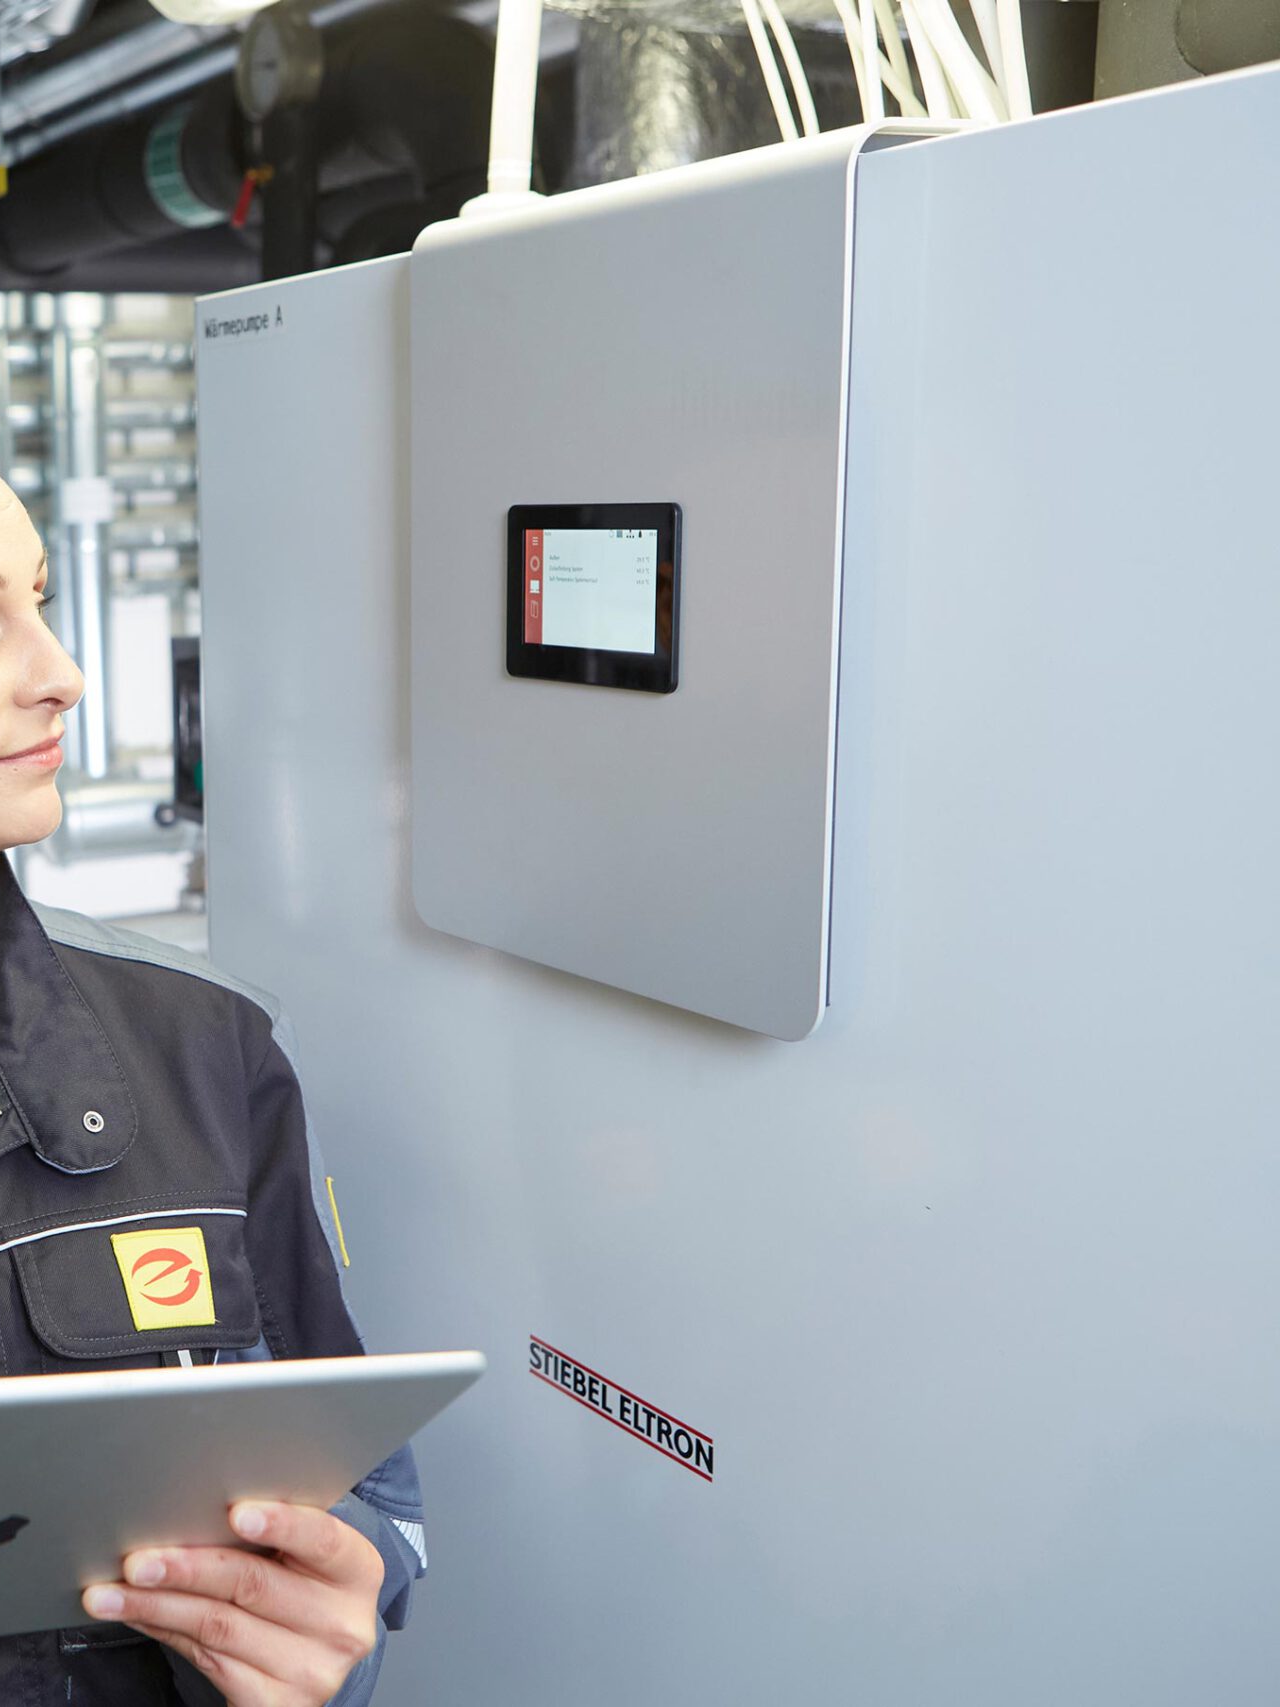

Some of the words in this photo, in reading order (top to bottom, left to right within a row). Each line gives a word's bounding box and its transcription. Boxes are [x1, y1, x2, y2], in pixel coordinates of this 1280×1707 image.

[204, 313, 269, 338] Wärmepumpe
[275, 304, 284, 327] A
[529, 1341, 613, 1415] STIEBEL
[619, 1393, 714, 1475] ELTRON
